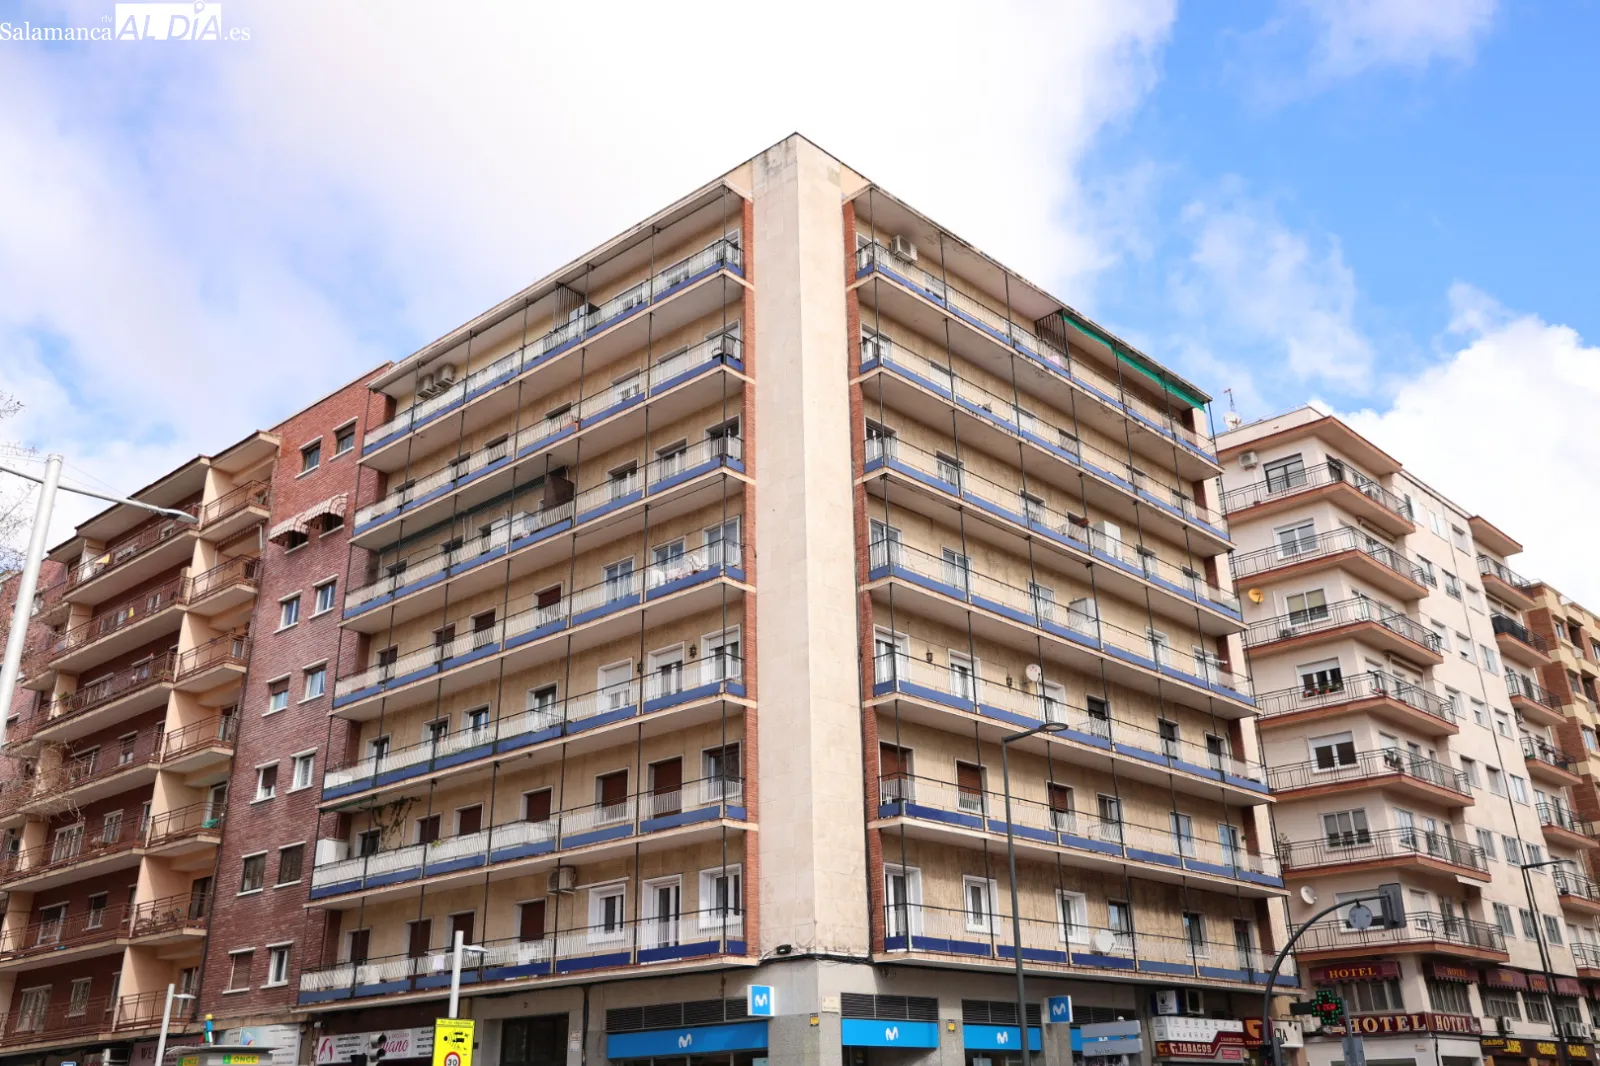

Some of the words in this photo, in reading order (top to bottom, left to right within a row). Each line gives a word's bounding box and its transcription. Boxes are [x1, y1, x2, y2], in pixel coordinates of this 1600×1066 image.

[1328, 967, 1377, 980] HOTEL
[1350, 1011, 1427, 1034] HOTEL
[1436, 1015, 1470, 1033] HOTEL
[1178, 1043, 1212, 1053] TABACOS
[1537, 1042, 1557, 1055] GADIS
[1568, 1044, 1587, 1057] GADIS
[233, 1055, 257, 1063] ONCE
[447, 1058, 458, 1066] 30
